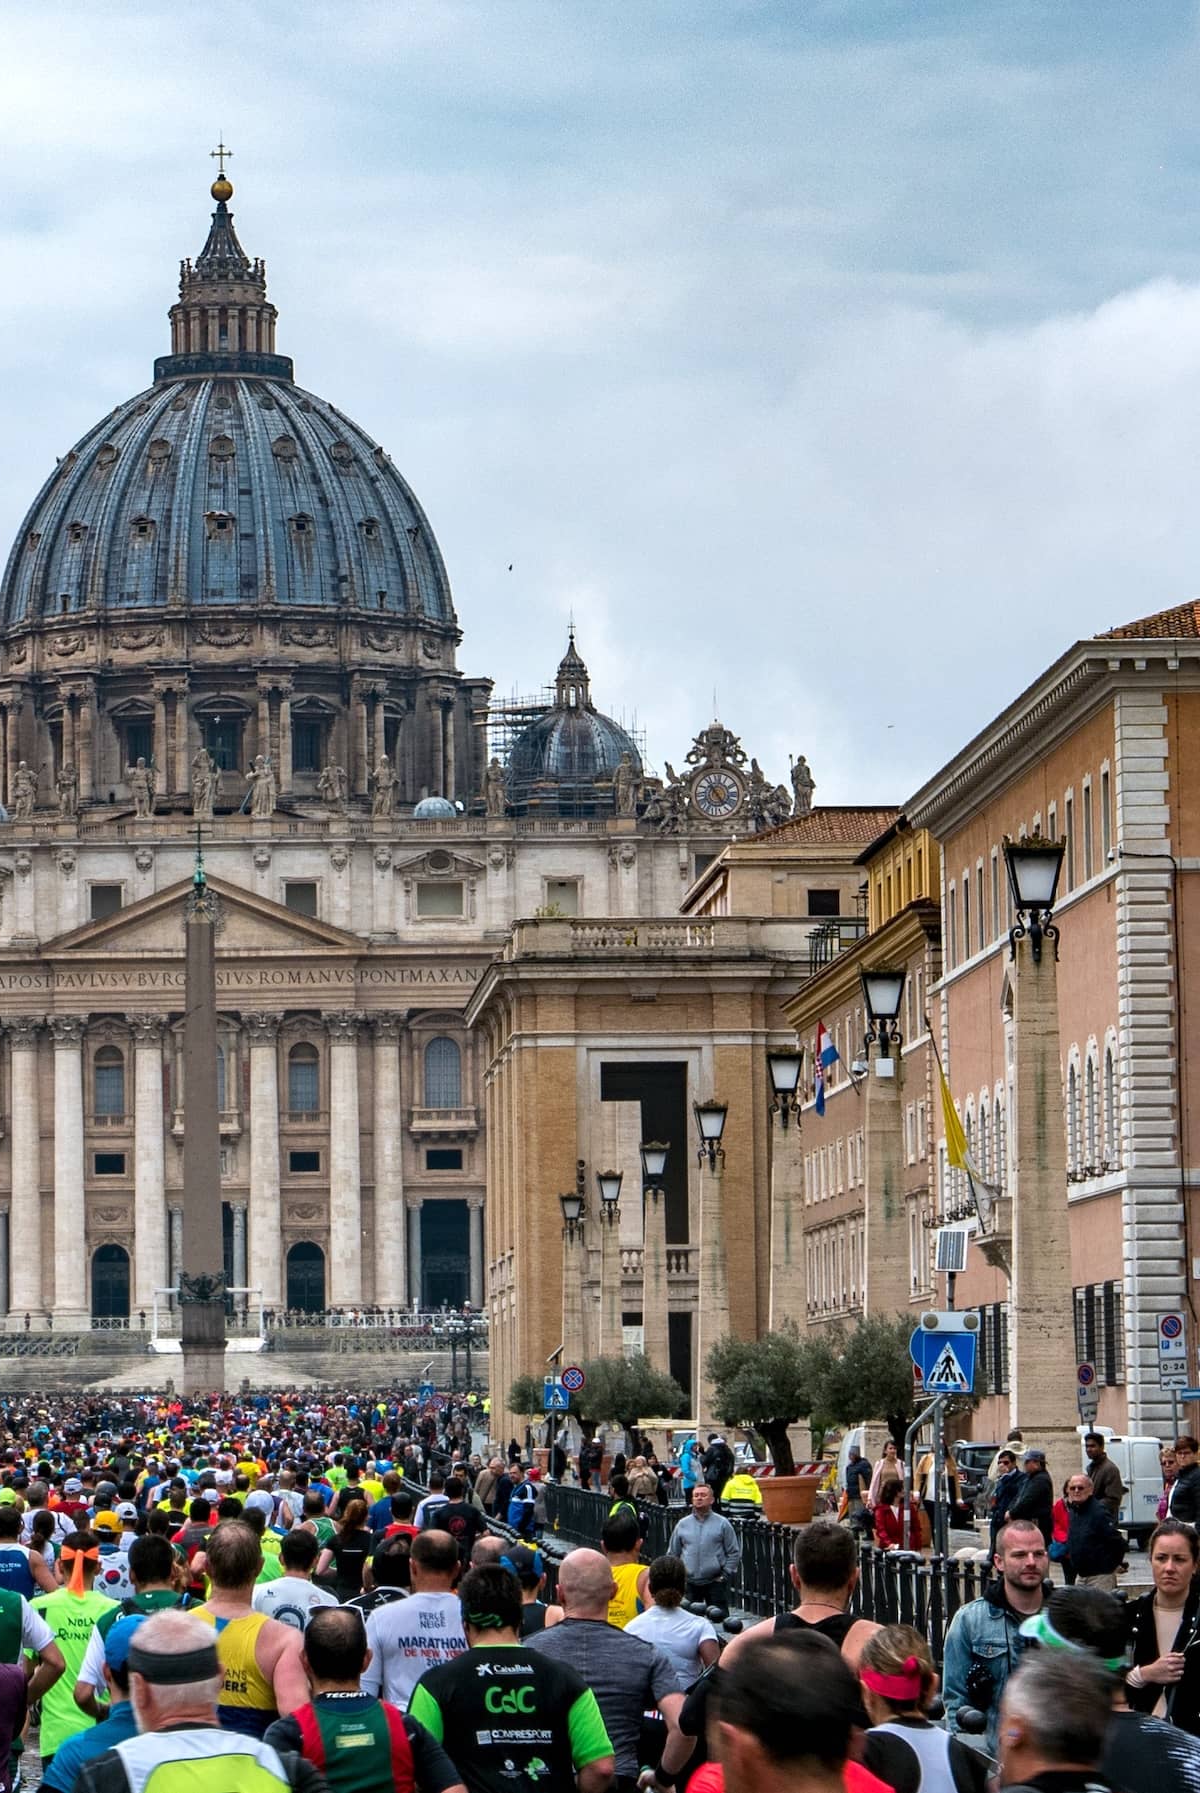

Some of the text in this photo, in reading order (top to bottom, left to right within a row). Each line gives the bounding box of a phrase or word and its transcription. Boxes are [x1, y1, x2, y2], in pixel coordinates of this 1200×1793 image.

[55, 972, 118, 987] PAVLVS
[259, 969, 354, 985] ROMANVS
[398, 1636, 466, 1649] MARATHON
[404, 1649, 417, 1658] DE
[225, 1668, 248, 1681] ANS
[491, 1730, 552, 1739] COMPRESPORT
